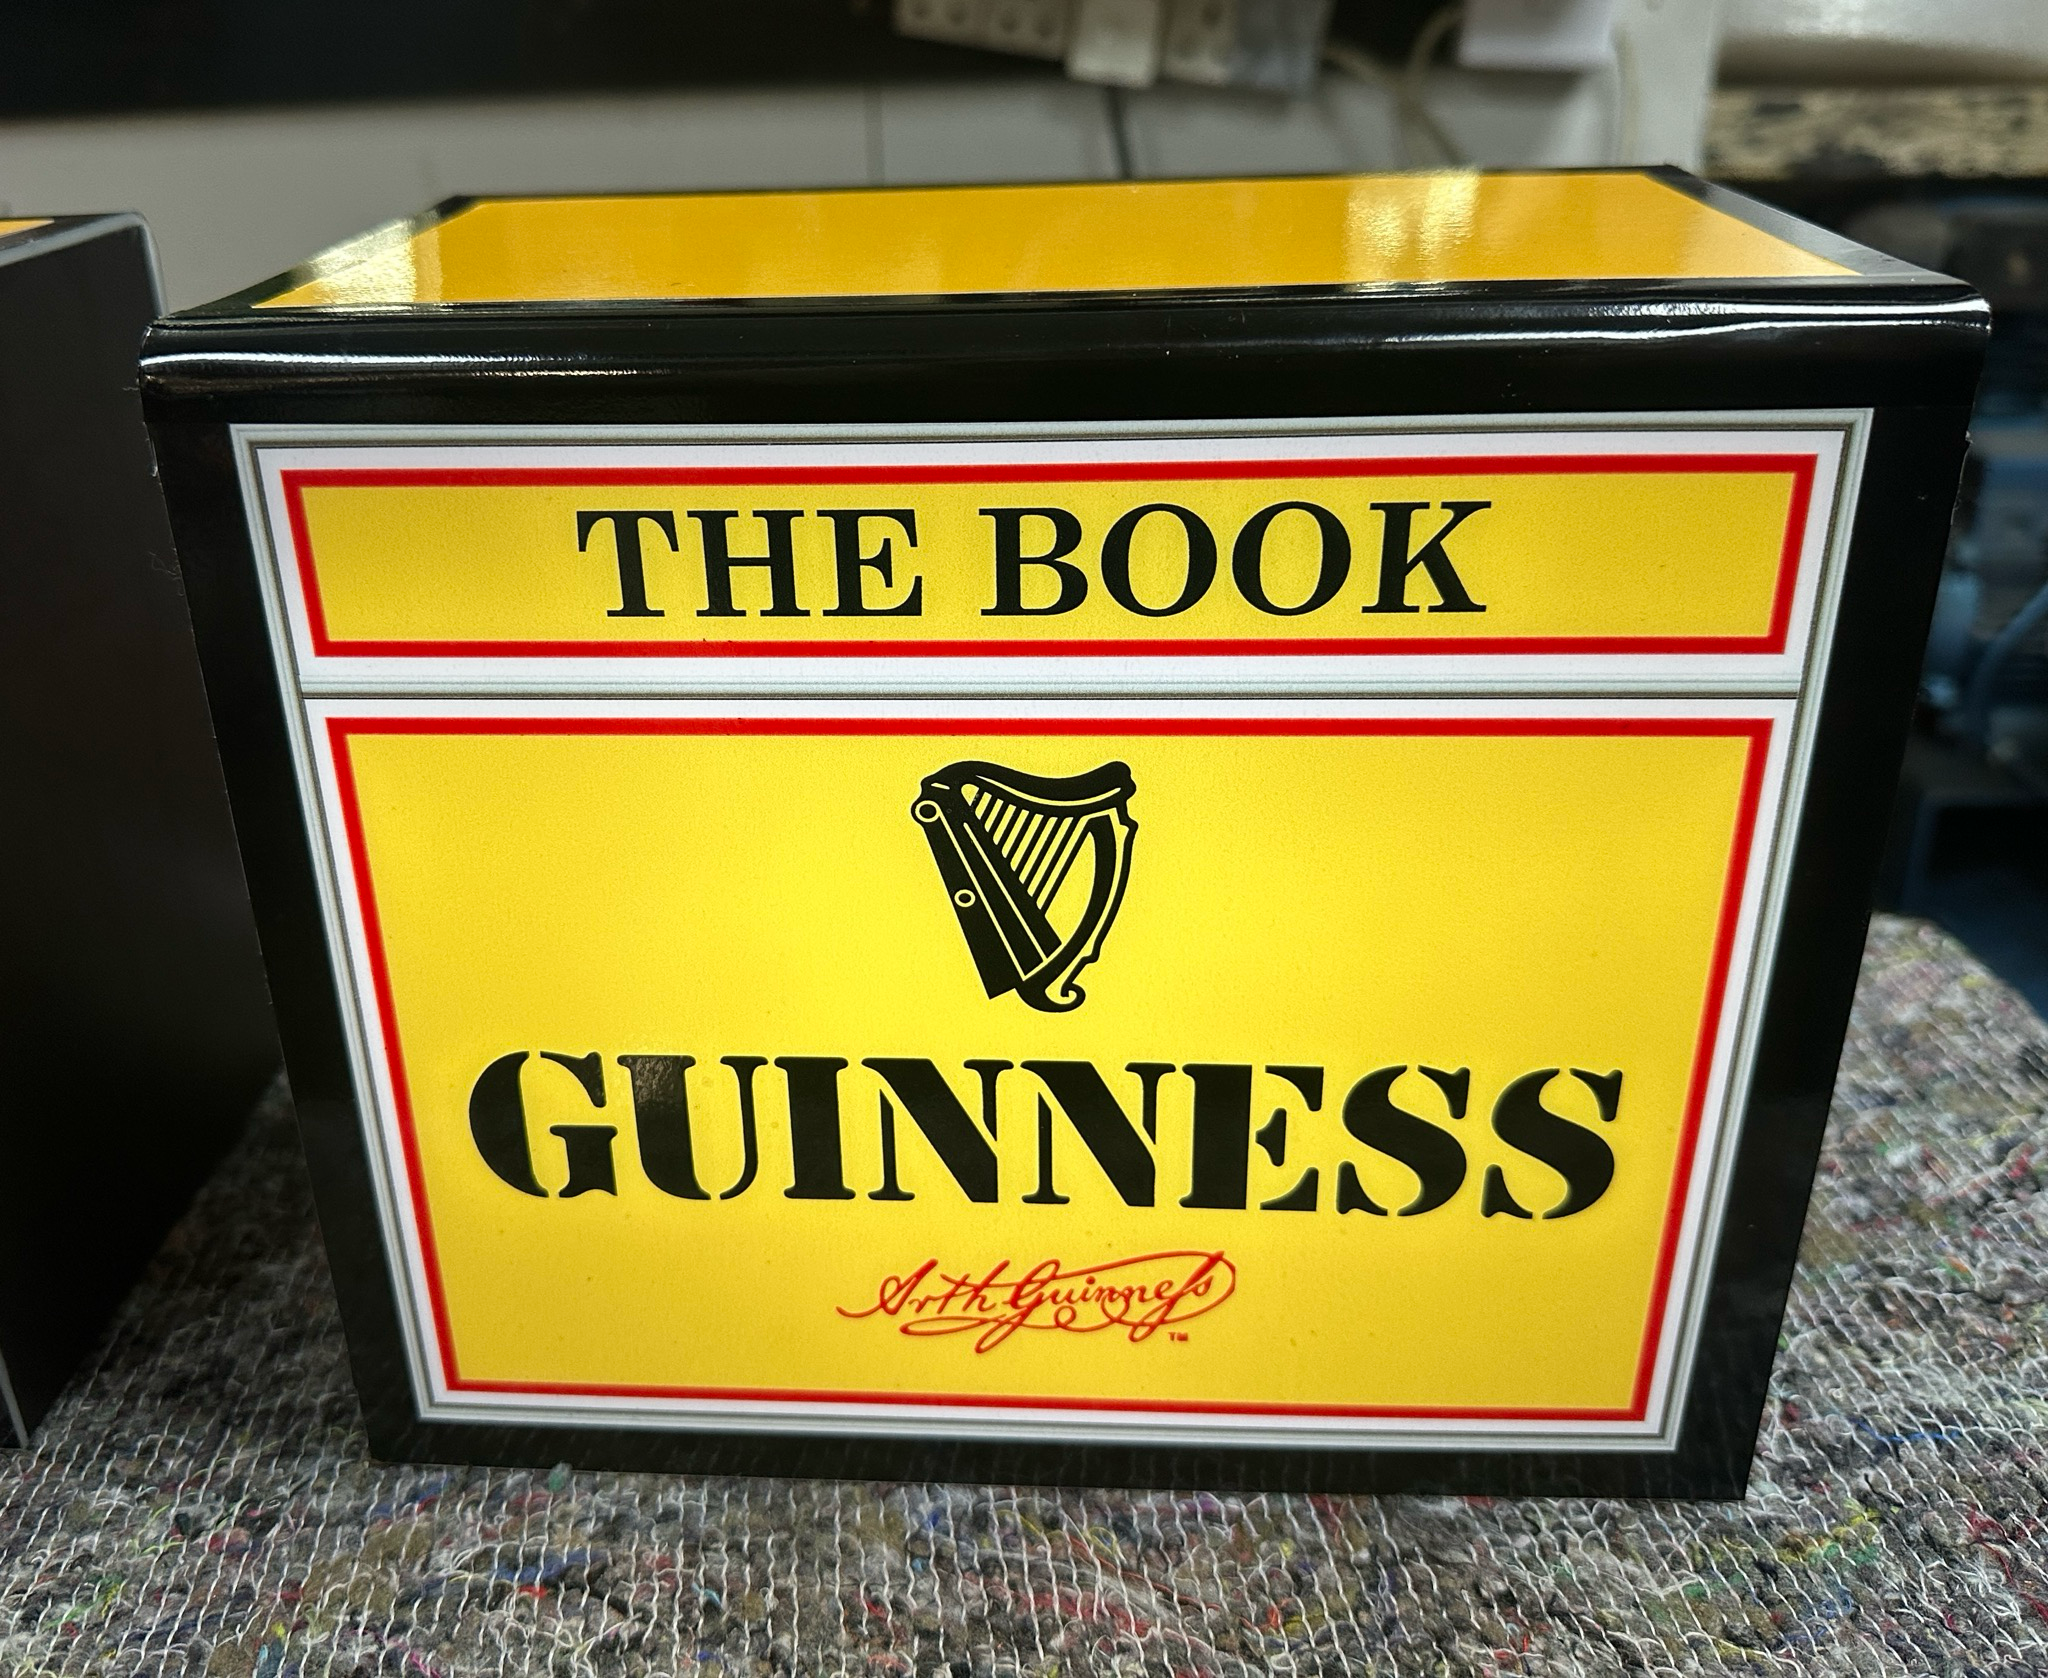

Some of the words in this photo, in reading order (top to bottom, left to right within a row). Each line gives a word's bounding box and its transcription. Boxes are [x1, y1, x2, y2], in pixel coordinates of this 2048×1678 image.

[576, 508, 923, 618] THE
[978, 500, 1492, 618] BOOK
[468, 1051, 1623, 1220] GUINNESS
